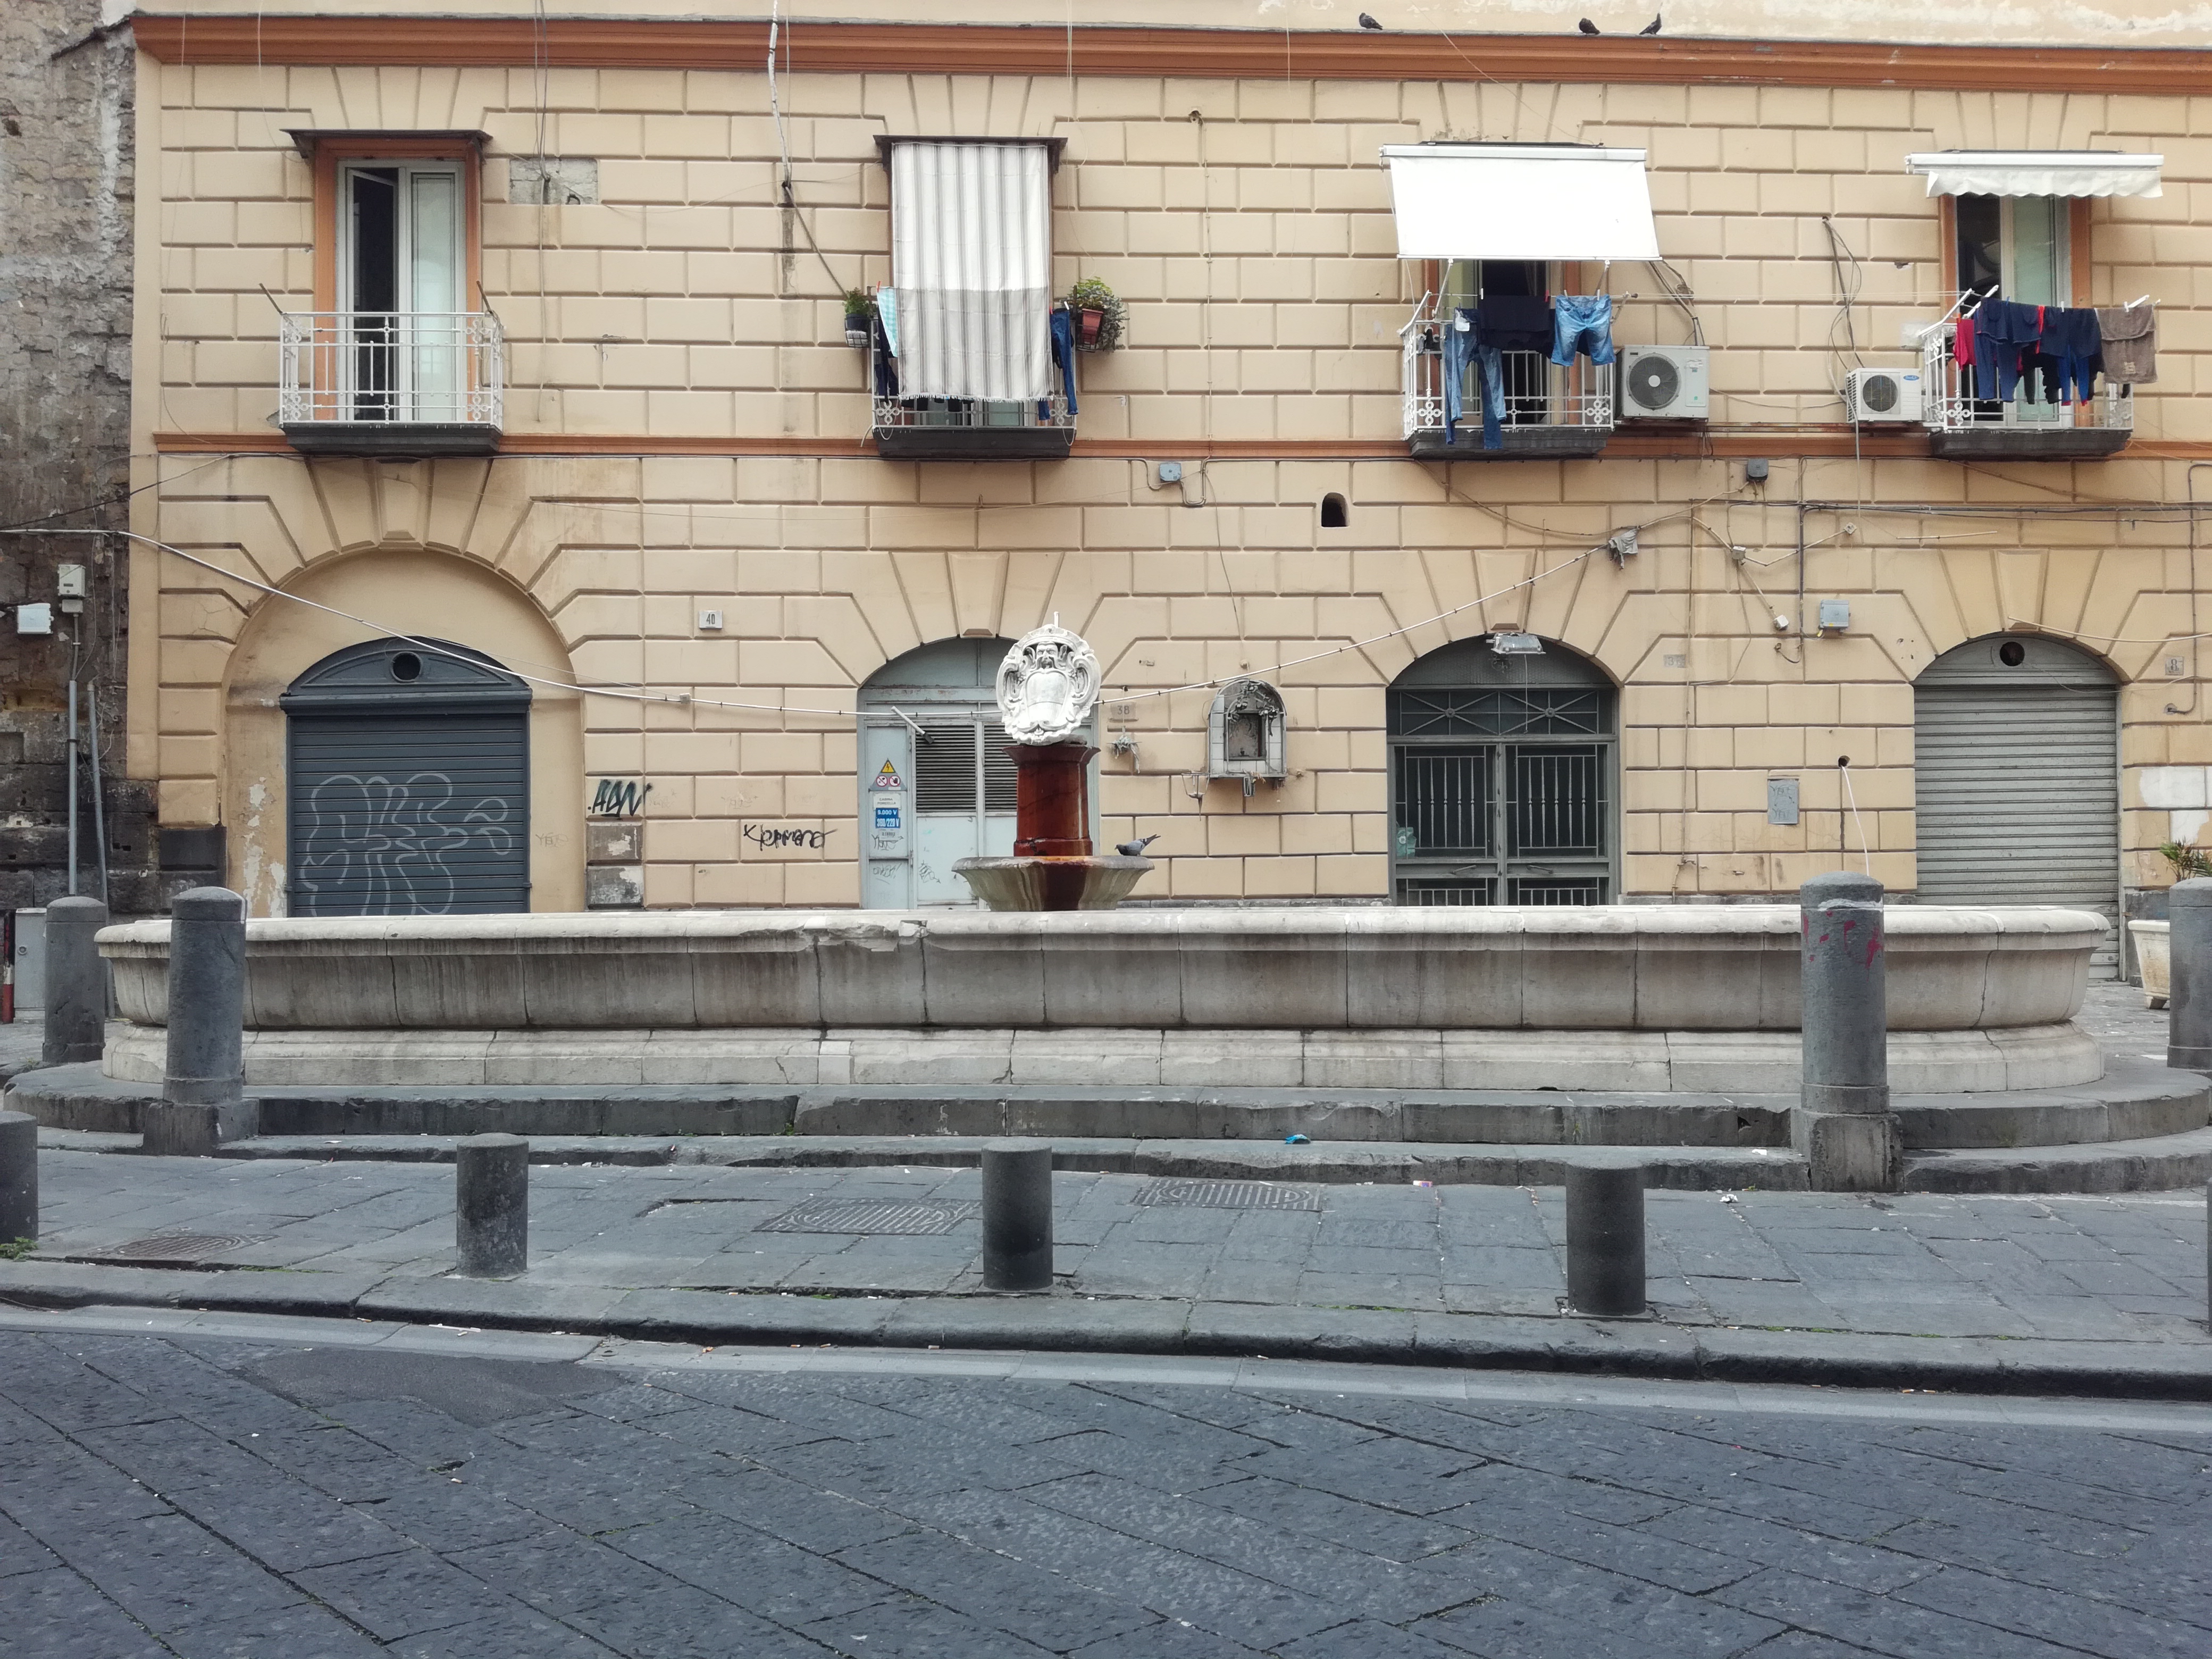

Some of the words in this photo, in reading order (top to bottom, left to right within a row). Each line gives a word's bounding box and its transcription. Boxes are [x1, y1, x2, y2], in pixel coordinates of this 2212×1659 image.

[706, 613, 715, 625] 40
[1117, 705, 1130, 715] 38
[896, 818, 899, 827] V
